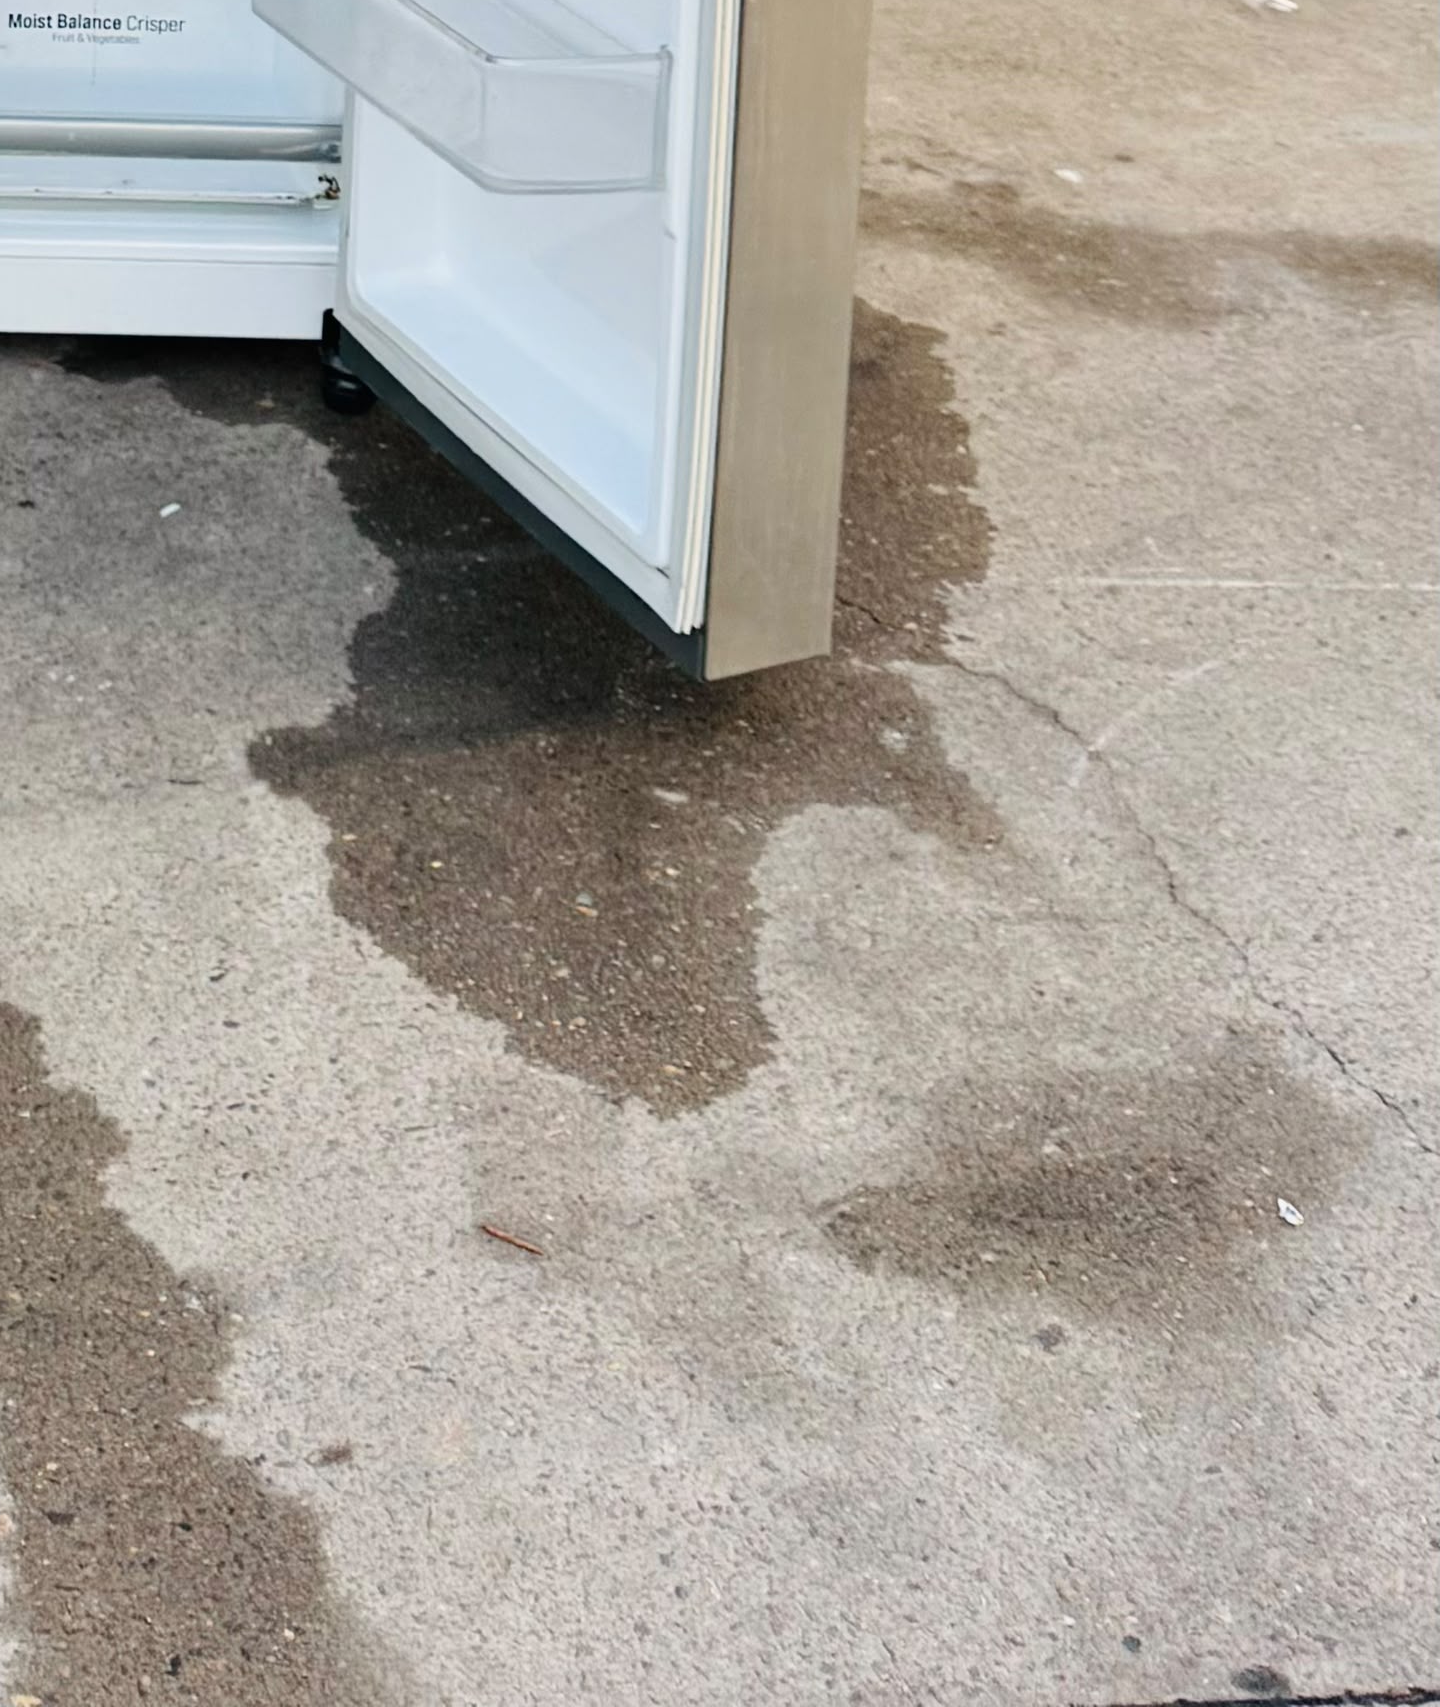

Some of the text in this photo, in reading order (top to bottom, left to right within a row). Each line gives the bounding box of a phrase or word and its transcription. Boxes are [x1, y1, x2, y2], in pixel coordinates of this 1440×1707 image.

[8, 13, 186, 35] Moist Balance Crisper
